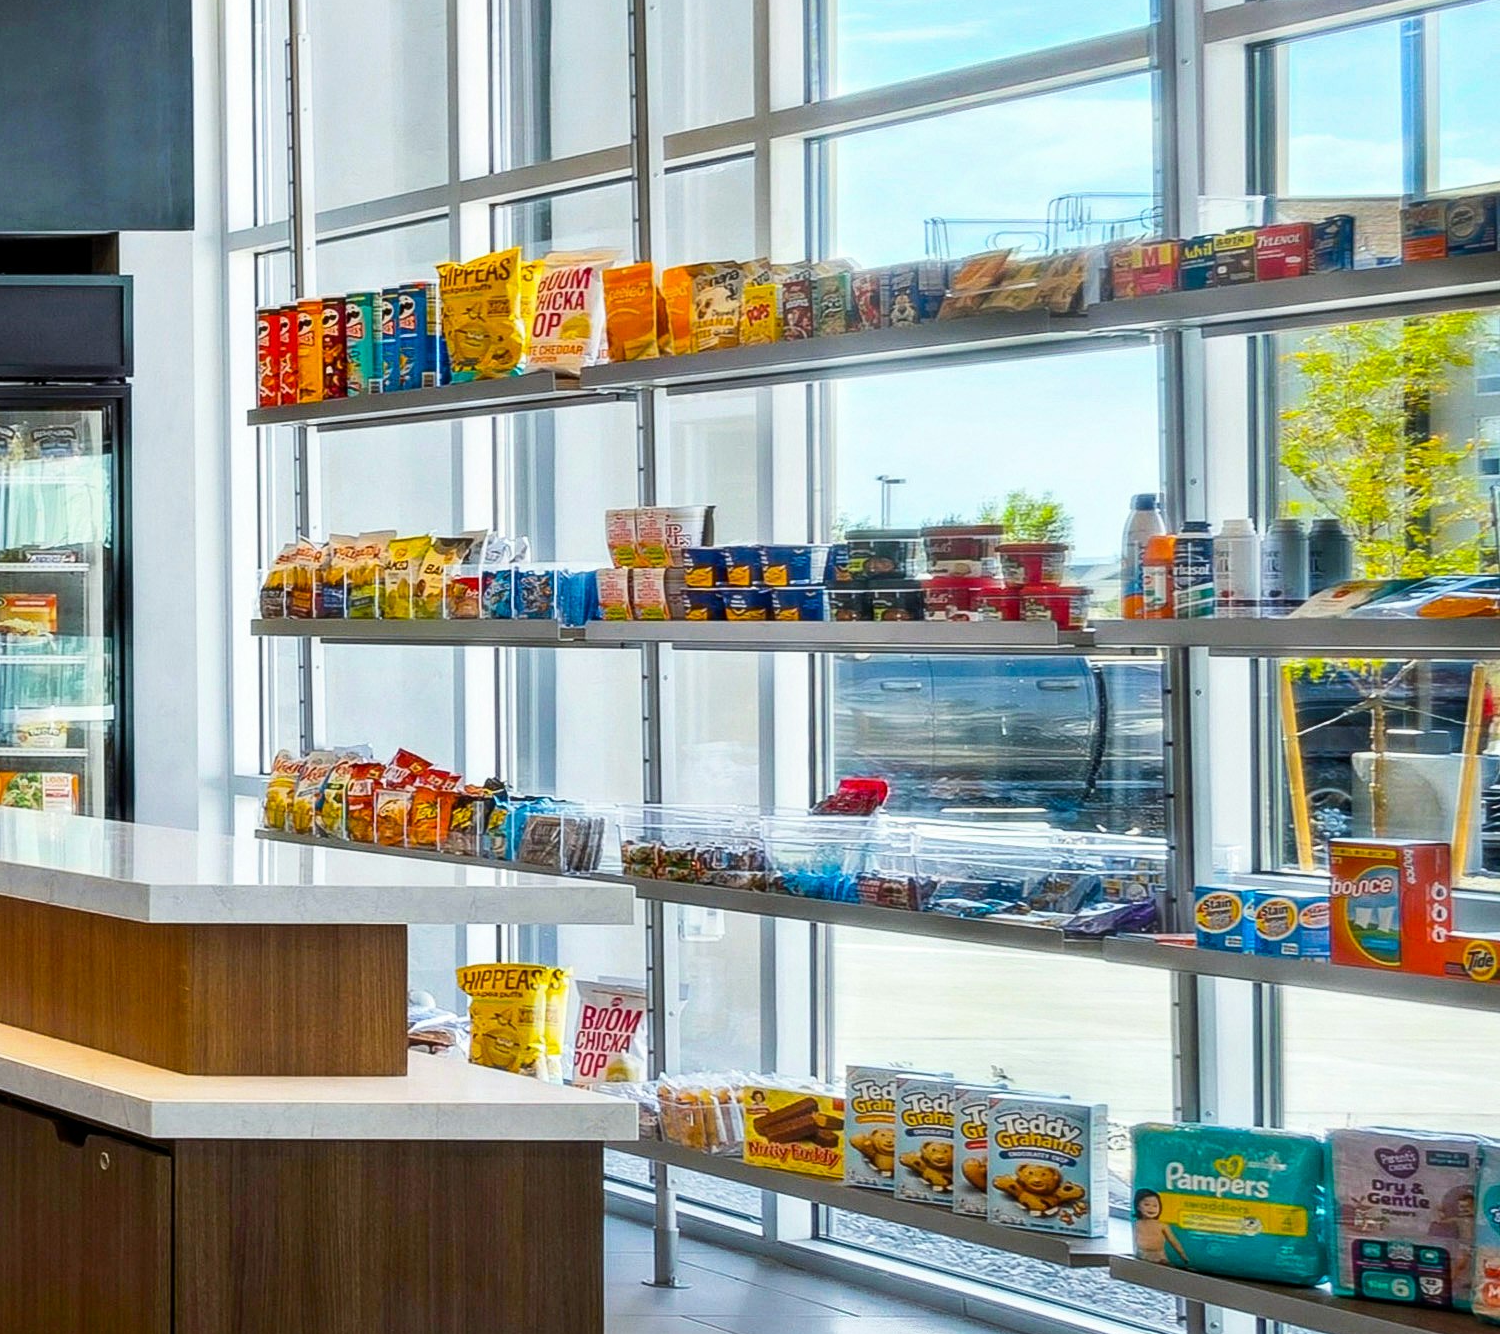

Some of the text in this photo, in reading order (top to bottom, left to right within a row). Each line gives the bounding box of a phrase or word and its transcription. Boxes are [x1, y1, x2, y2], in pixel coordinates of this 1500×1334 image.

[1182, 242, 1212, 260] Advil
[1257, 234, 1301, 249] TYLENOL
[440, 258, 511, 288] HIPPEAS
[538, 267, 593, 294] BOOM
[536, 291, 585, 312] HICKA
[532, 312, 562, 338] OP
[539, 344, 584, 356] CHEDDAR
[1173, 563, 1211, 576] rbasol
[1404, 848, 1417, 885] bounce
[1331, 877, 1392, 897] bounce
[1203, 899, 1232, 910] Stain
[1261, 905, 1289, 916] Stain
[1466, 950, 1494, 971] Tide
[463, 969, 545, 991] HIPPEAS
[580, 1005, 643, 1035] BOOM
[575, 1030, 631, 1054] CHICKA
[852, 1079, 896, 1101] Ted
[852, 1098, 896, 1115] Grah
[902, 1092, 955, 1115] Ted
[902, 1110, 955, 1128] Graha
[996, 1113, 1083, 1144] Teddy
[996, 1130, 1084, 1158] Grahams
[1379, 1149, 1417, 1165] Parent's
[1165, 1162, 1270, 1199] Pampers
[1372, 1179, 1425, 1196] Dry &
[1183, 1200, 1250, 1214] swaddlers
[1367, 1192, 1430, 1209] Gentle
[1391, 1278, 1411, 1297] 6
